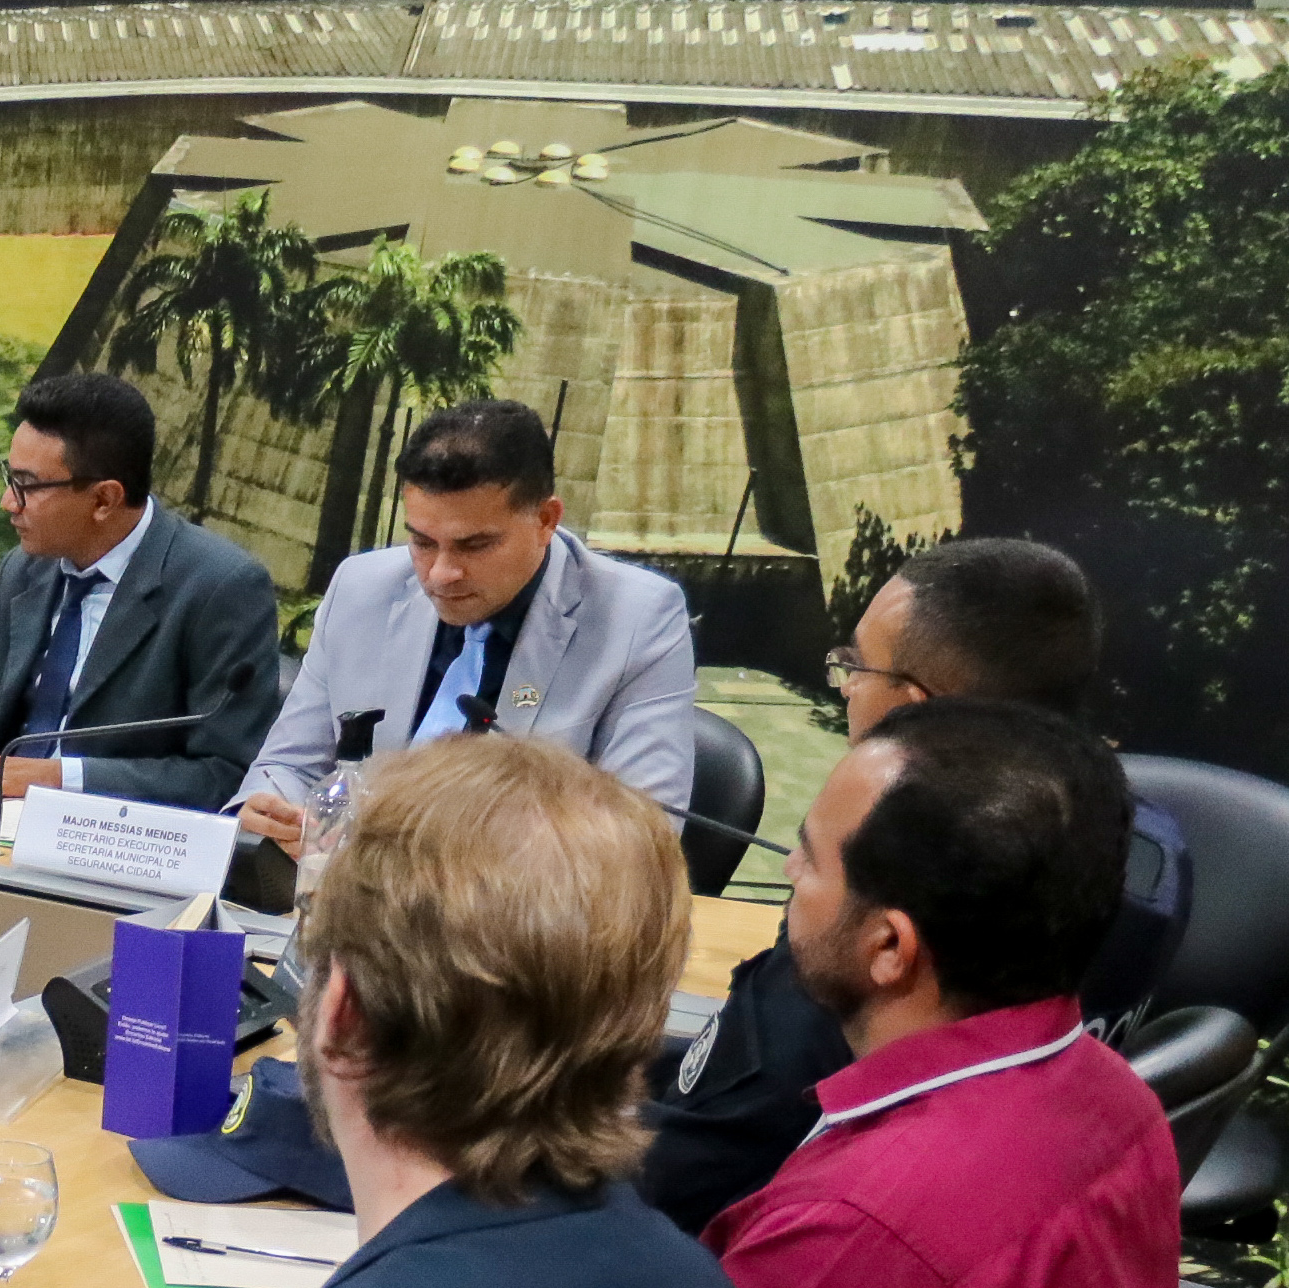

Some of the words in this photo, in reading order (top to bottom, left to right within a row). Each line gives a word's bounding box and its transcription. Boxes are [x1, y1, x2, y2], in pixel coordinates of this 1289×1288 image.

[56, 828, 115, 846] SECRETÁRIO
[117, 837, 171, 855] EXECUTIVO
[173, 847, 187, 858] NA
[62, 815, 97, 829] MAJOR
[98, 821, 143, 836] MESSIAS
[145, 828, 188, 843] MENDES
[57, 840, 113, 858] SECRETARIA
[114, 850, 165, 867] MUNICIPAL
[166, 859, 180, 870] DE
[68, 855, 125, 875] SEGURANÇA
